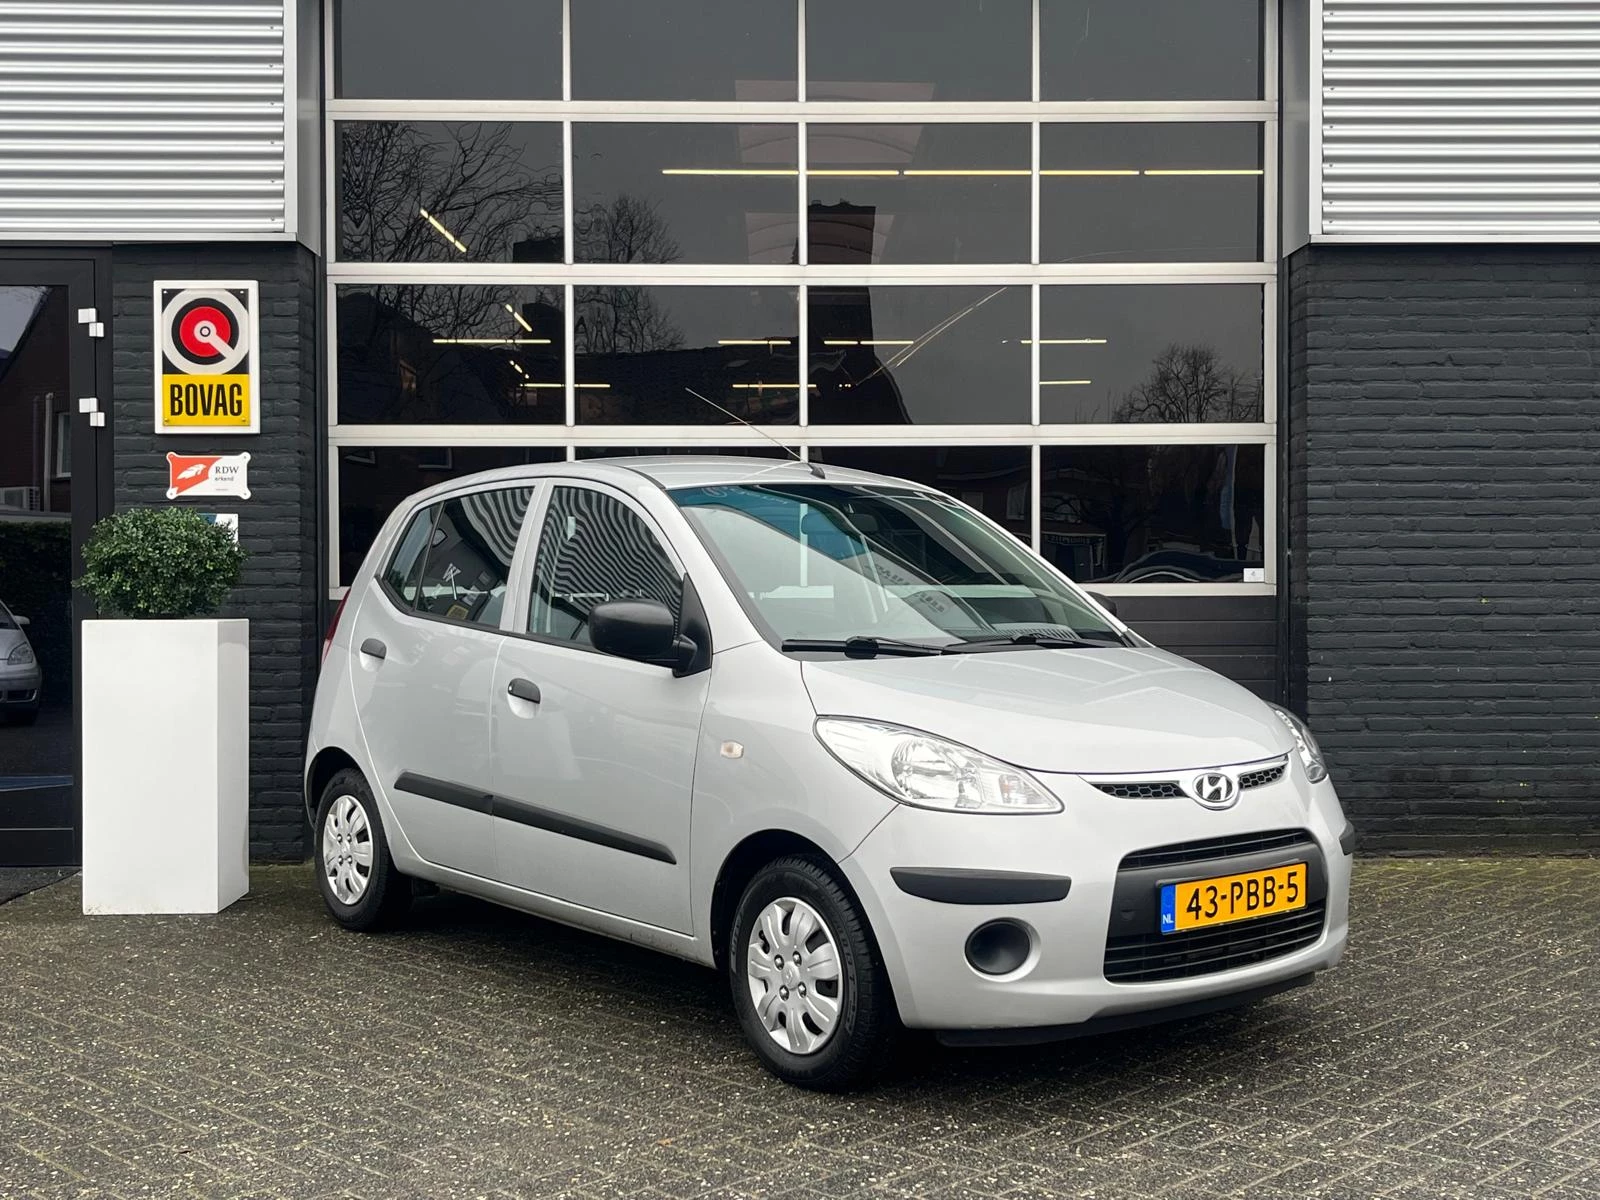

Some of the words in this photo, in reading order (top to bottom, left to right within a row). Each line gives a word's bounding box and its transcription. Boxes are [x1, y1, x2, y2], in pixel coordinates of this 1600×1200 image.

[170, 383, 243, 416] BOVAG
[215, 466, 240, 474] RDW
[1186, 871, 1299, 921] 43-PBB-5
[1162, 914, 1174, 924] NL
